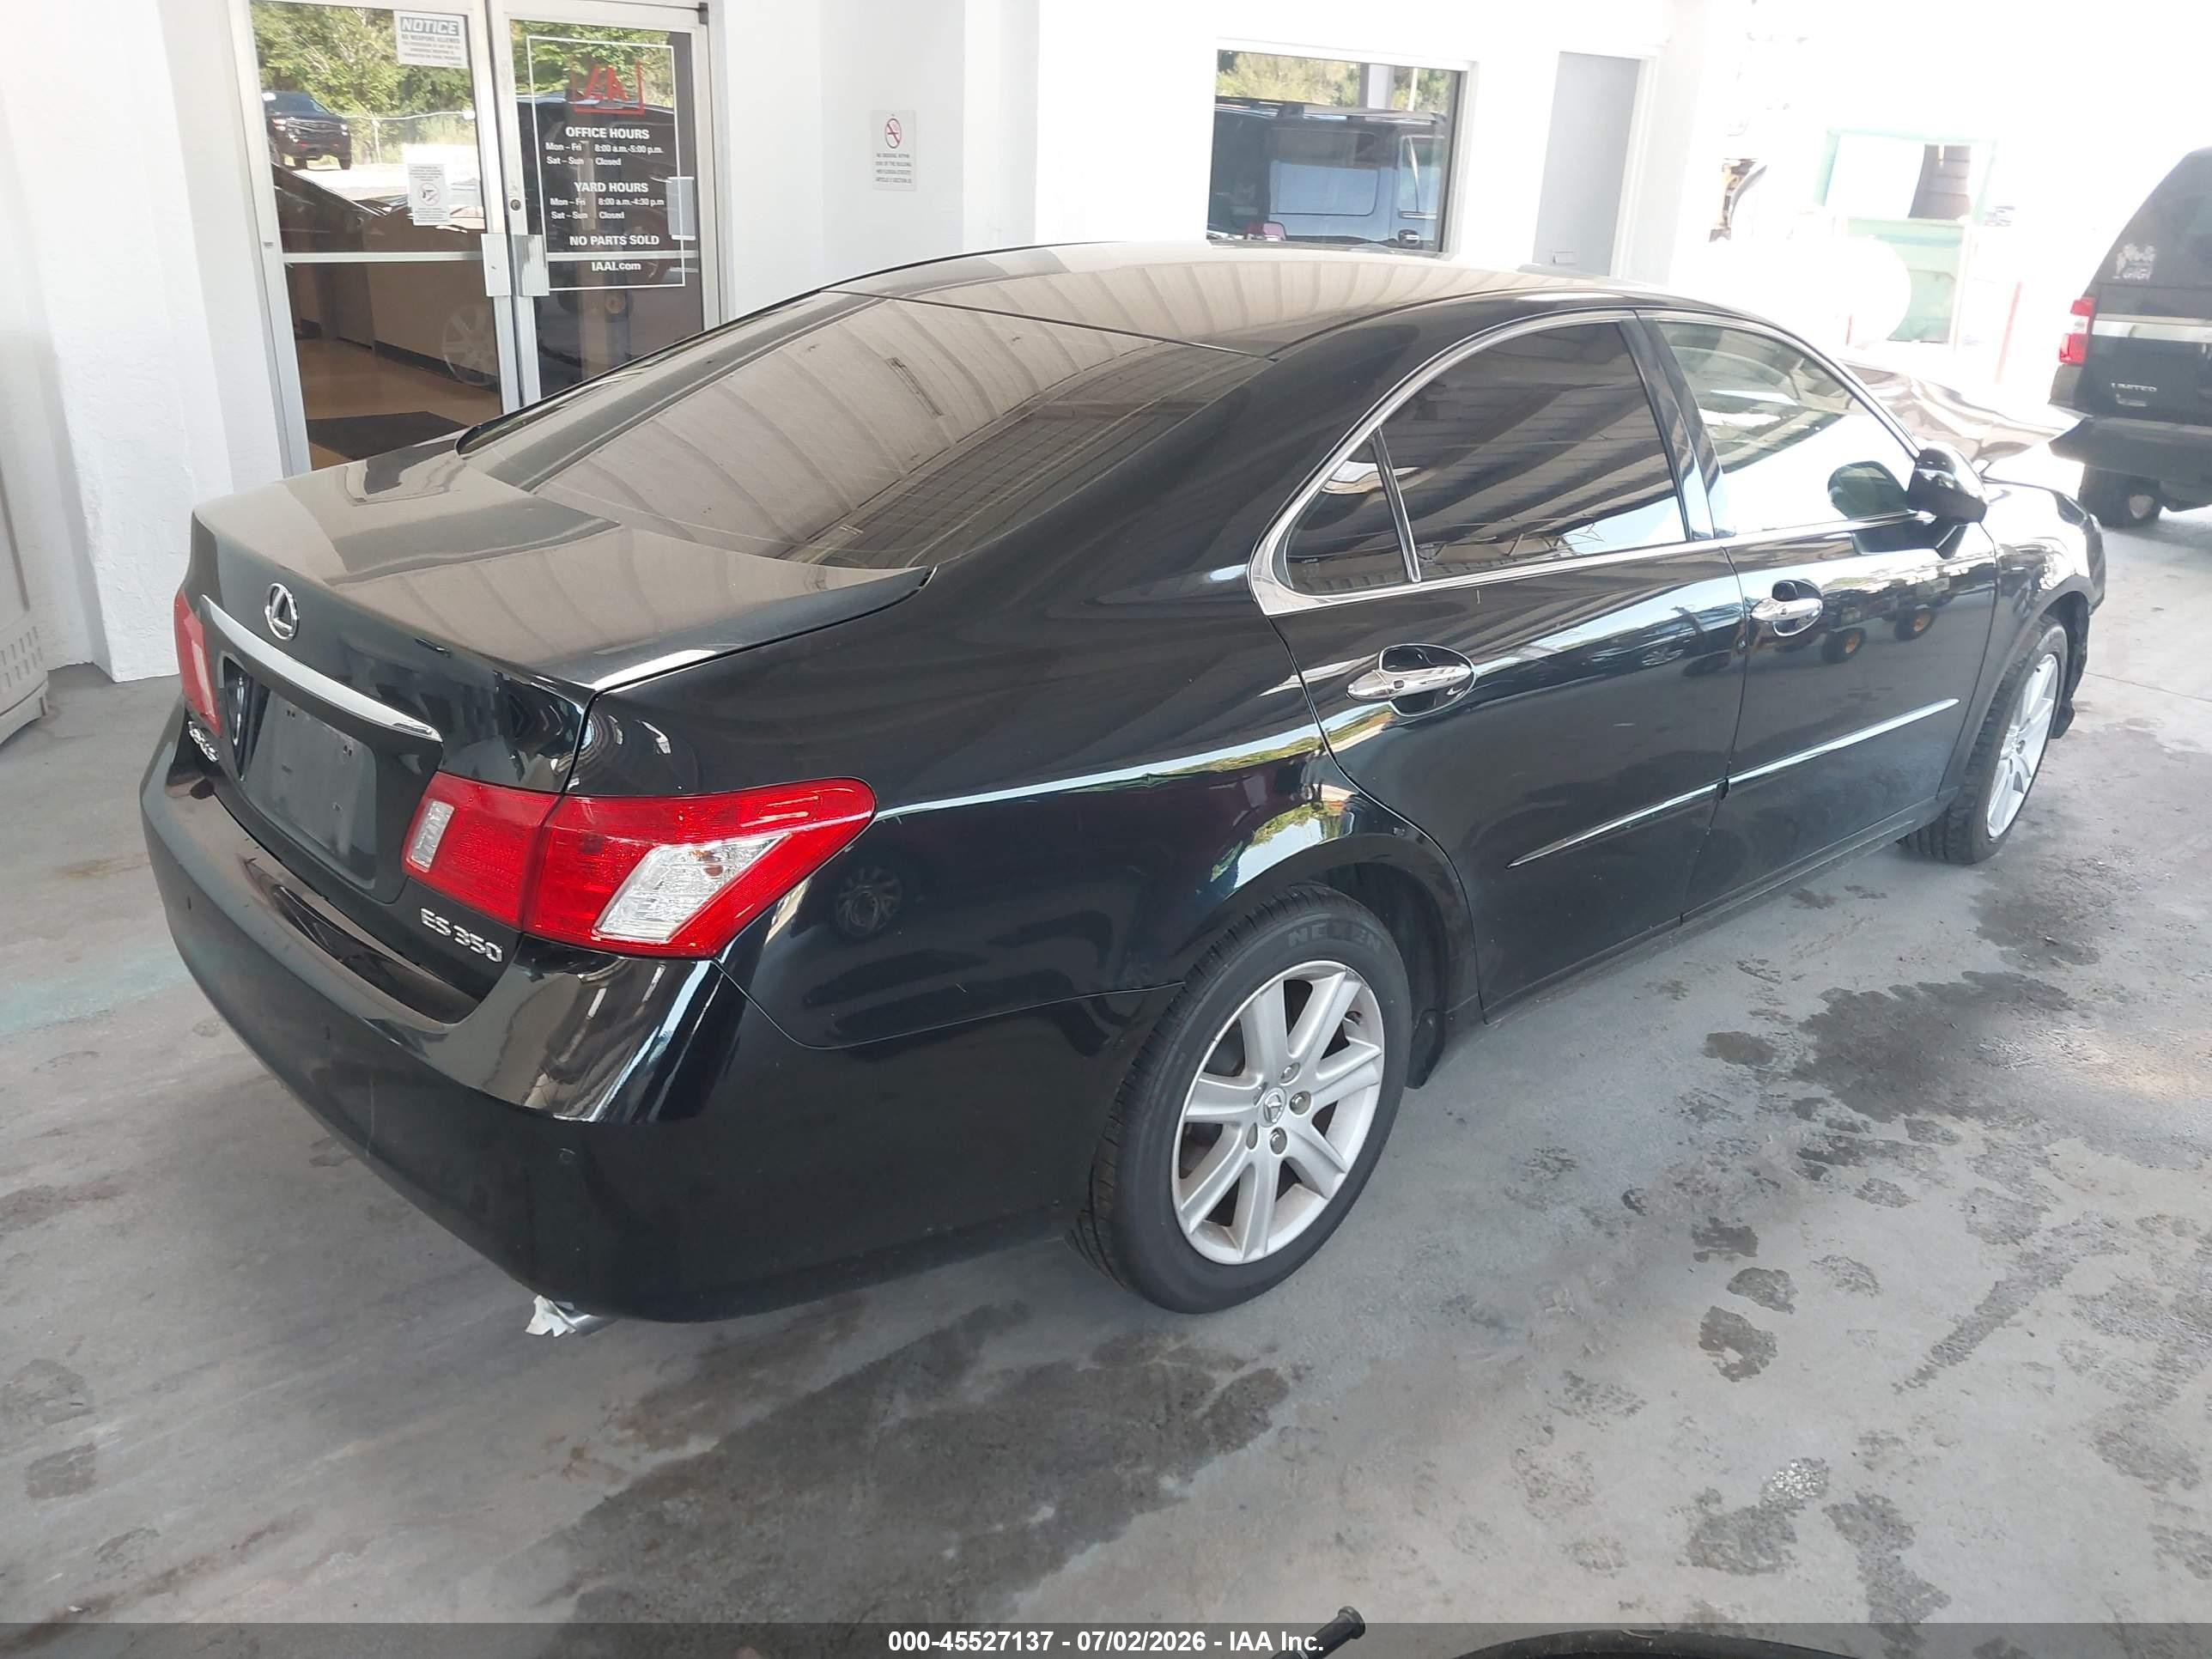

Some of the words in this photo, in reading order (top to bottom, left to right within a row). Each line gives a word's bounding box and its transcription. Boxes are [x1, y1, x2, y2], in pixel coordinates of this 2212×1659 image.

[402, 18, 458, 34] NOTICE
[565, 126, 607, 137] OFFICE
[610, 128, 650, 139] HOURS
[545, 142, 564, 150] Mon
[571, 143, 582, 151] Fri
[594, 143, 611, 152] 8:00
[647, 146, 664, 155] p.m.
[595, 157, 621, 166] Closed
[574, 182, 606, 192] YARD
[609, 182, 649, 193] HOURS
[575, 198, 586, 206] Fri
[569, 236, 587, 246] NO
[591, 236, 628, 246] PARTS
[629, 235, 659, 245] SOLD
[592, 261, 641, 271] IAAI.com
[420, 908, 452, 936] ES
[453, 925, 502, 963] 350
[1288, 921, 1382, 954] NEEN
